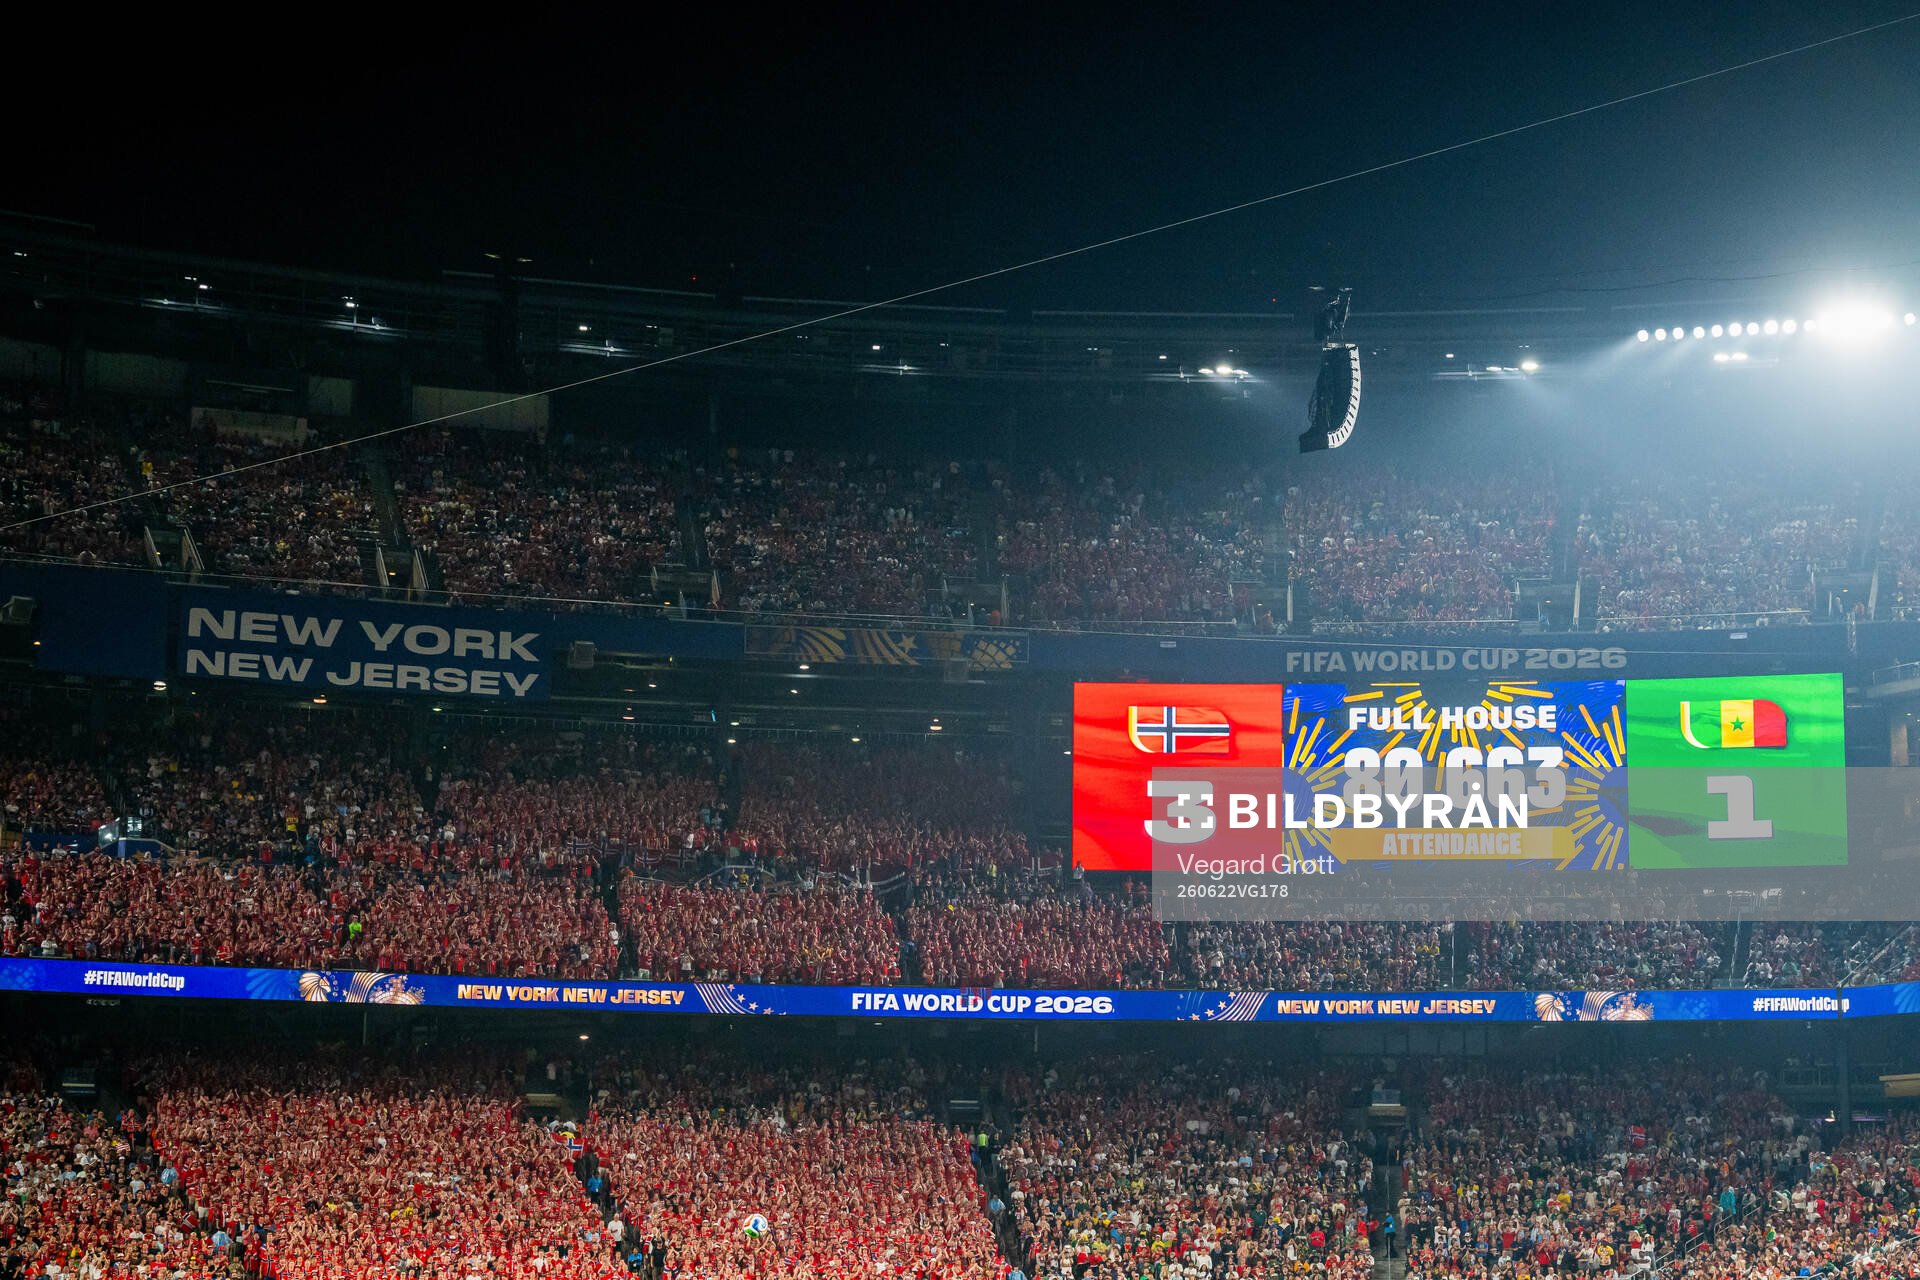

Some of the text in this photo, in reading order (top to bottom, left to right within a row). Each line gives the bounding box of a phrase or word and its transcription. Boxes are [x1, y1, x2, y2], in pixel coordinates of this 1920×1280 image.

[188, 607, 541, 662] NEW YORK
[186, 649, 540, 697] NEW JERSEY
[1286, 647, 1628, 673] FIFA WORLD CUP 2026
[1349, 705, 1557, 731] FULL HOUSE
[1343, 746, 1567, 810] 80 663
[1144, 780, 1217, 844] 3
[1706, 775, 1773, 840] 1
[1382, 832, 1522, 855] ATTENDANCE
[84, 970, 185, 991] #FIFAWorldCup
[457, 984, 685, 1005] NEW YORK NEW JERSEY
[852, 993, 1113, 1014] FIFA WORLD CUP 2026
[1277, 999, 1496, 1015] NEW YORK NEW JERSEY
[1753, 996, 1850, 1013] #FIFAWorldCup
